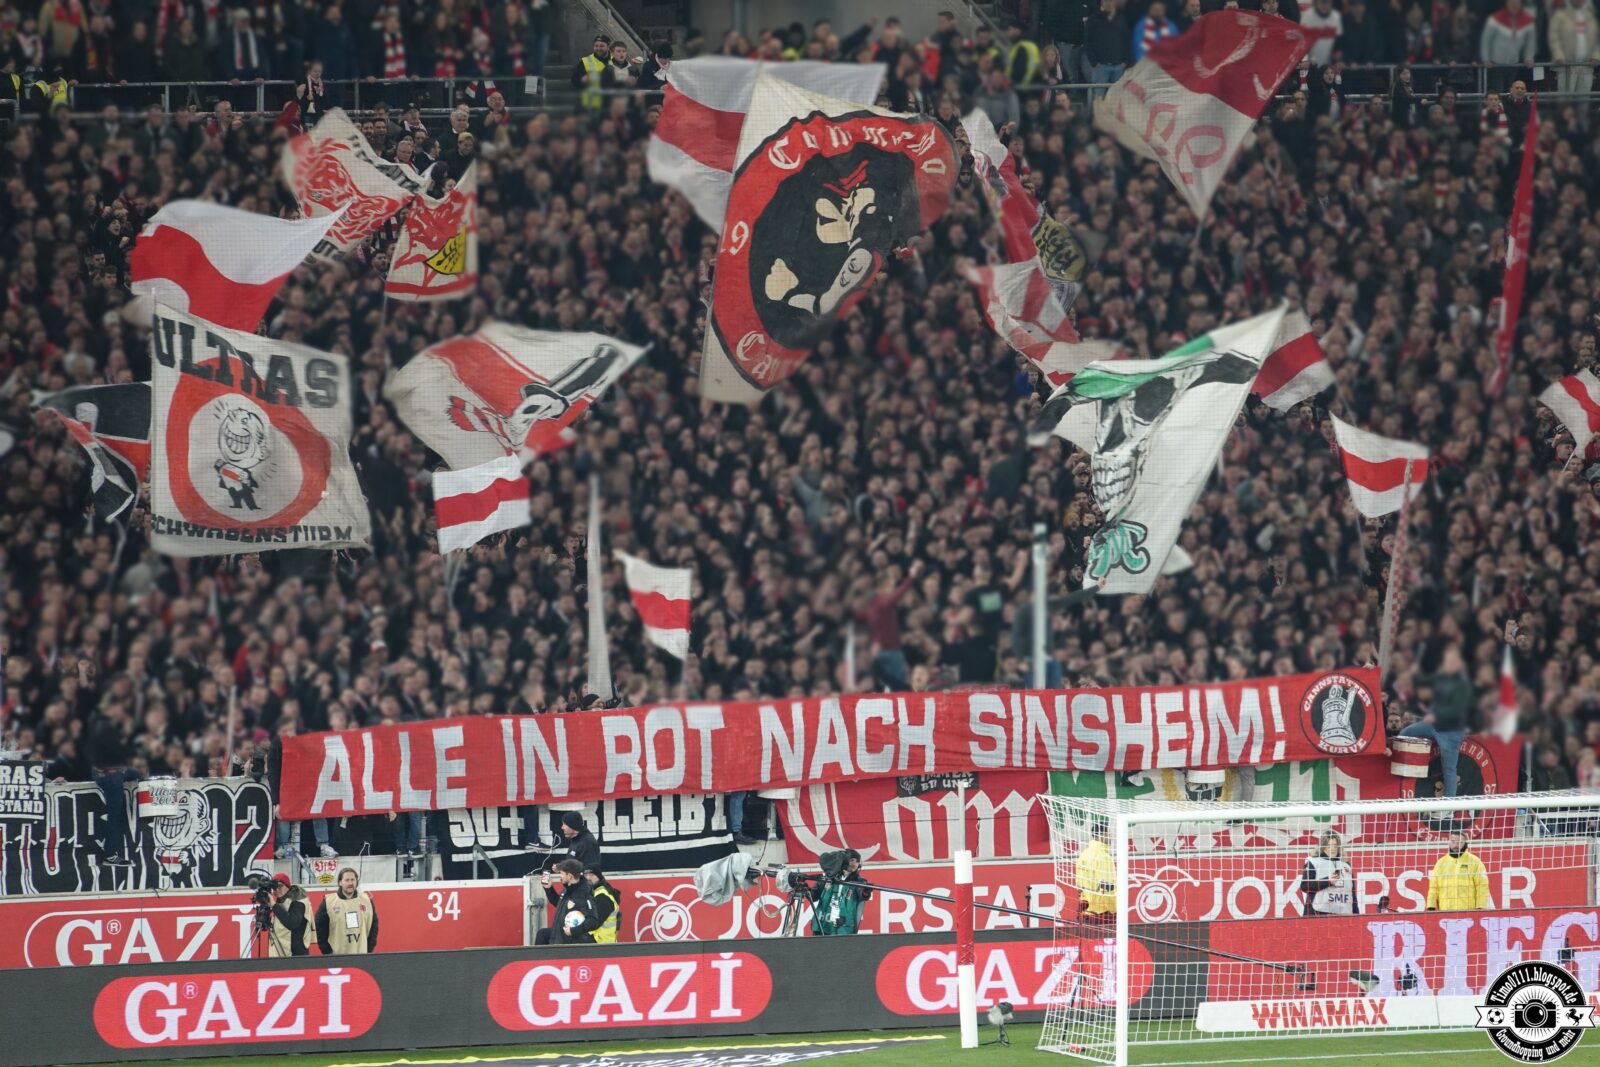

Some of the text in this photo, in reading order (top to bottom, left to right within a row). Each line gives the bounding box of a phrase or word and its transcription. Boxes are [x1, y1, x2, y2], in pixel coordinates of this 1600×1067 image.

[153, 313, 339, 409] ULTRAS
[310, 686, 1285, 814] ALLE IN ROT NACH SINSHEIM!
[427, 891, 461, 921] 34
[346, 934, 360, 943] TV
[1251, 998, 1389, 1029] WINAMAX
